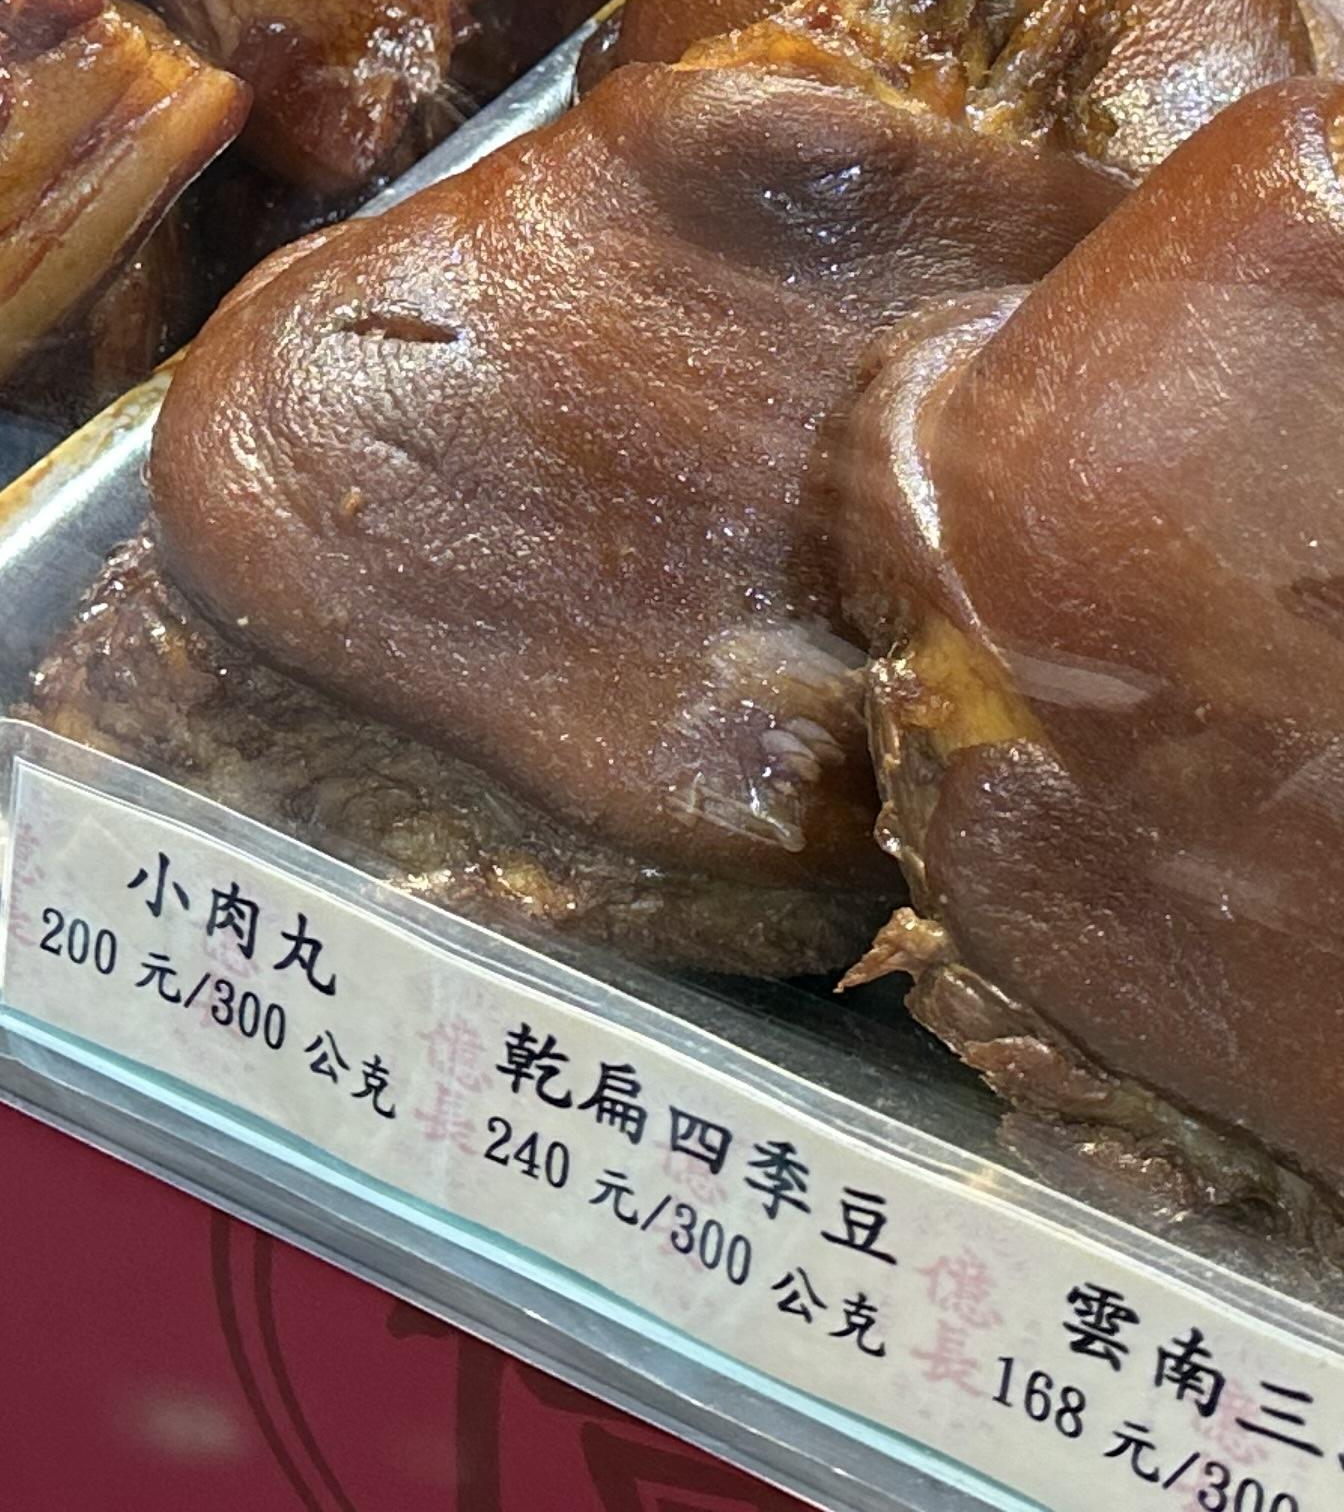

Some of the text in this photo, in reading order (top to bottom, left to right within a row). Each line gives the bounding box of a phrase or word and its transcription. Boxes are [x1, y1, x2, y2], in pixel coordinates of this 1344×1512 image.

[39, 908, 396, 1120] 200 元/300 公克
[128, 851, 337, 996] 小肉丸
[483, 1116, 886, 1358] 240 元/300 公克
[496, 1022, 898, 1266] 乾扁四季豆
[992, 1356, 1087, 1439] 168
